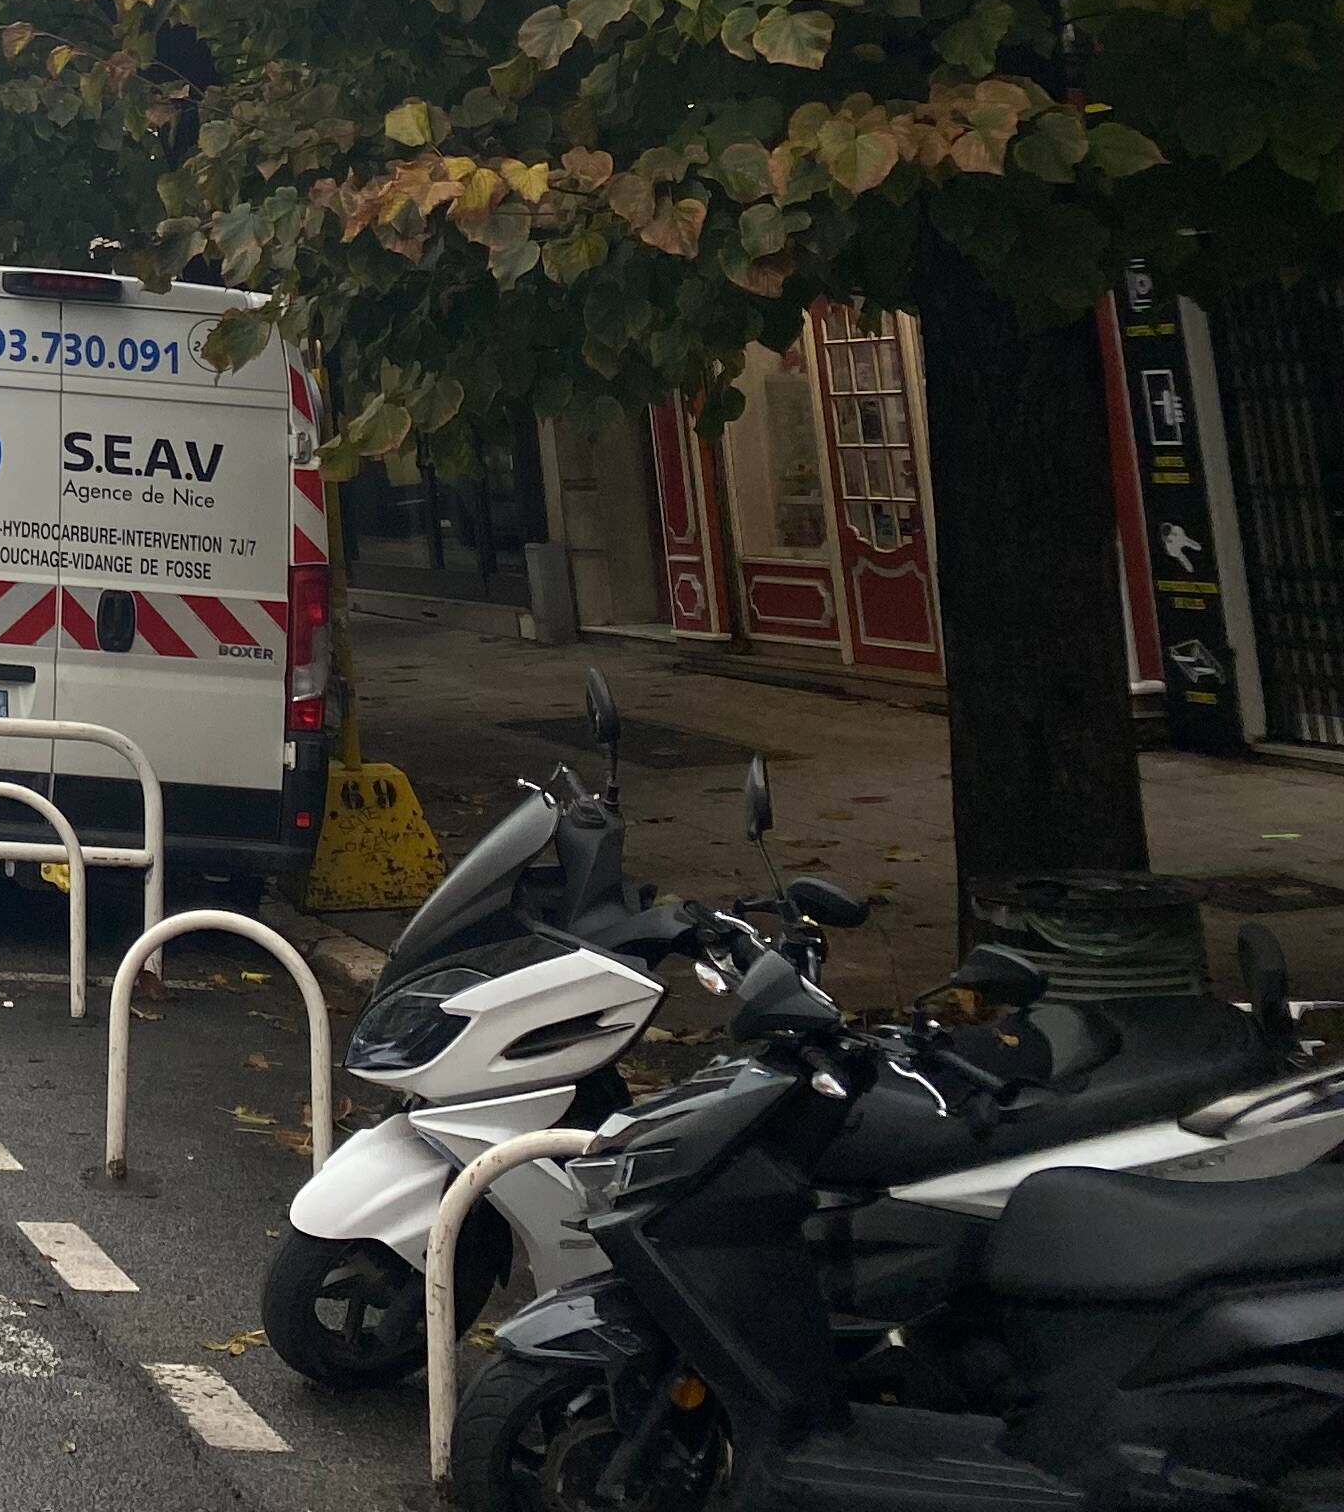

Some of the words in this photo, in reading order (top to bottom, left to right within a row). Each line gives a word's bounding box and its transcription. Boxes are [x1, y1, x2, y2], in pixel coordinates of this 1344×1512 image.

[63, 431, 224, 483] S.E.A.V
[62, 479, 132, 504] Agence
[142, 484, 164, 504] de
[172, 487, 215, 509] Nice
[228, 538, 257, 557] 7J/7
[140, 559, 159, 576] DE
[165, 560, 212, 580] FOSSE
[217, 644, 274, 662] BOXER
